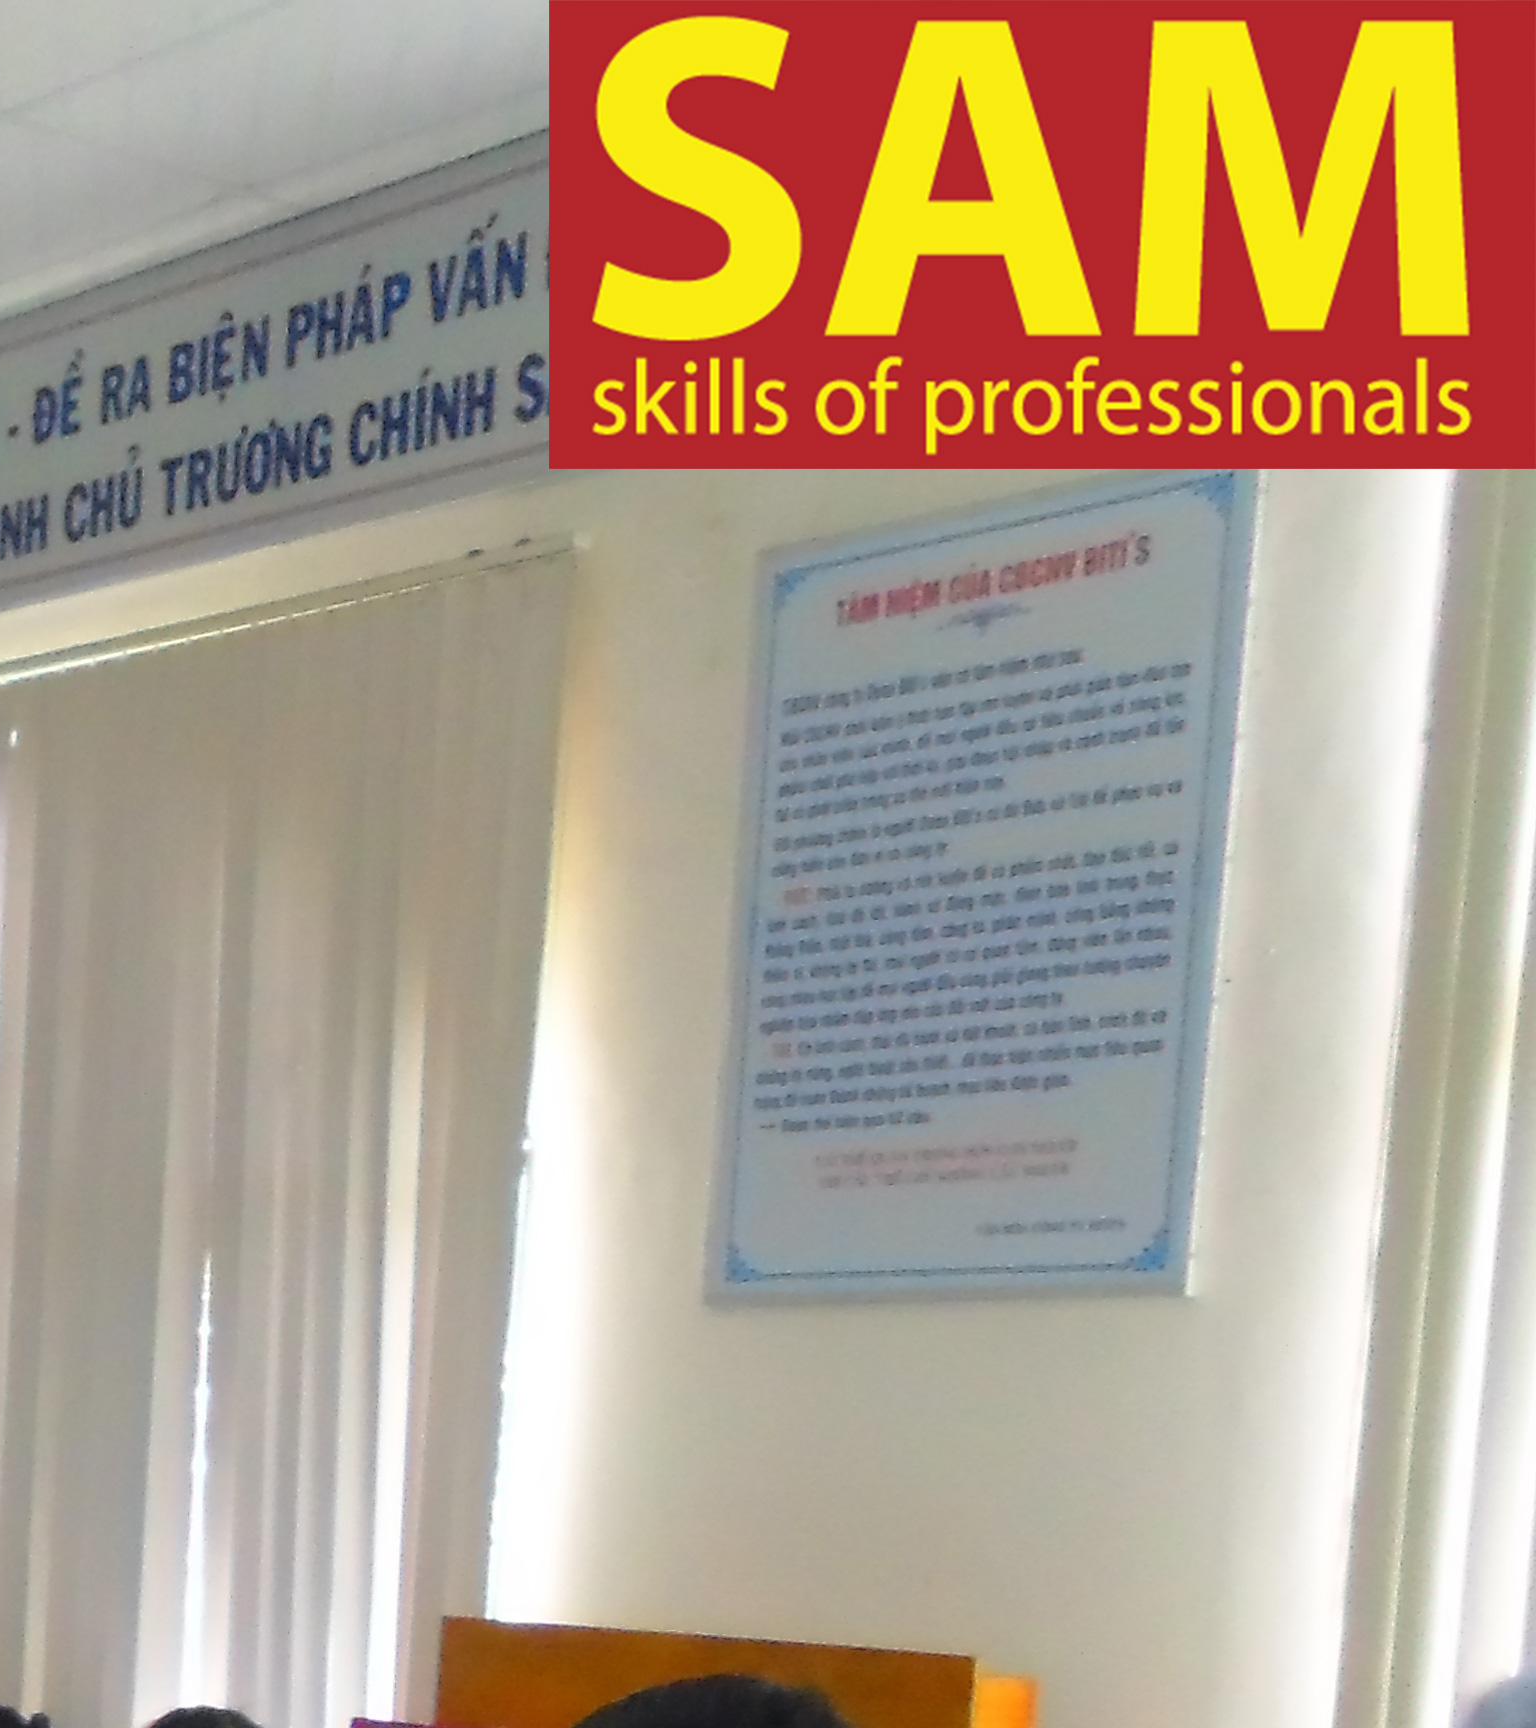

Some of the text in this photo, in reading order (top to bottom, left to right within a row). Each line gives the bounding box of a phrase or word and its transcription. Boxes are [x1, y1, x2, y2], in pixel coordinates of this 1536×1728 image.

[101, 354, 152, 426] RA
[167, 310, 270, 404] BIỆN
[285, 263, 412, 368] PHÁP
[427, 212, 529, 324] VẤN
[63, 444, 144, 544] CHỦ
[160, 413, 333, 516] TRƯƠNG
[349, 366, 496, 467] CHÍNH
